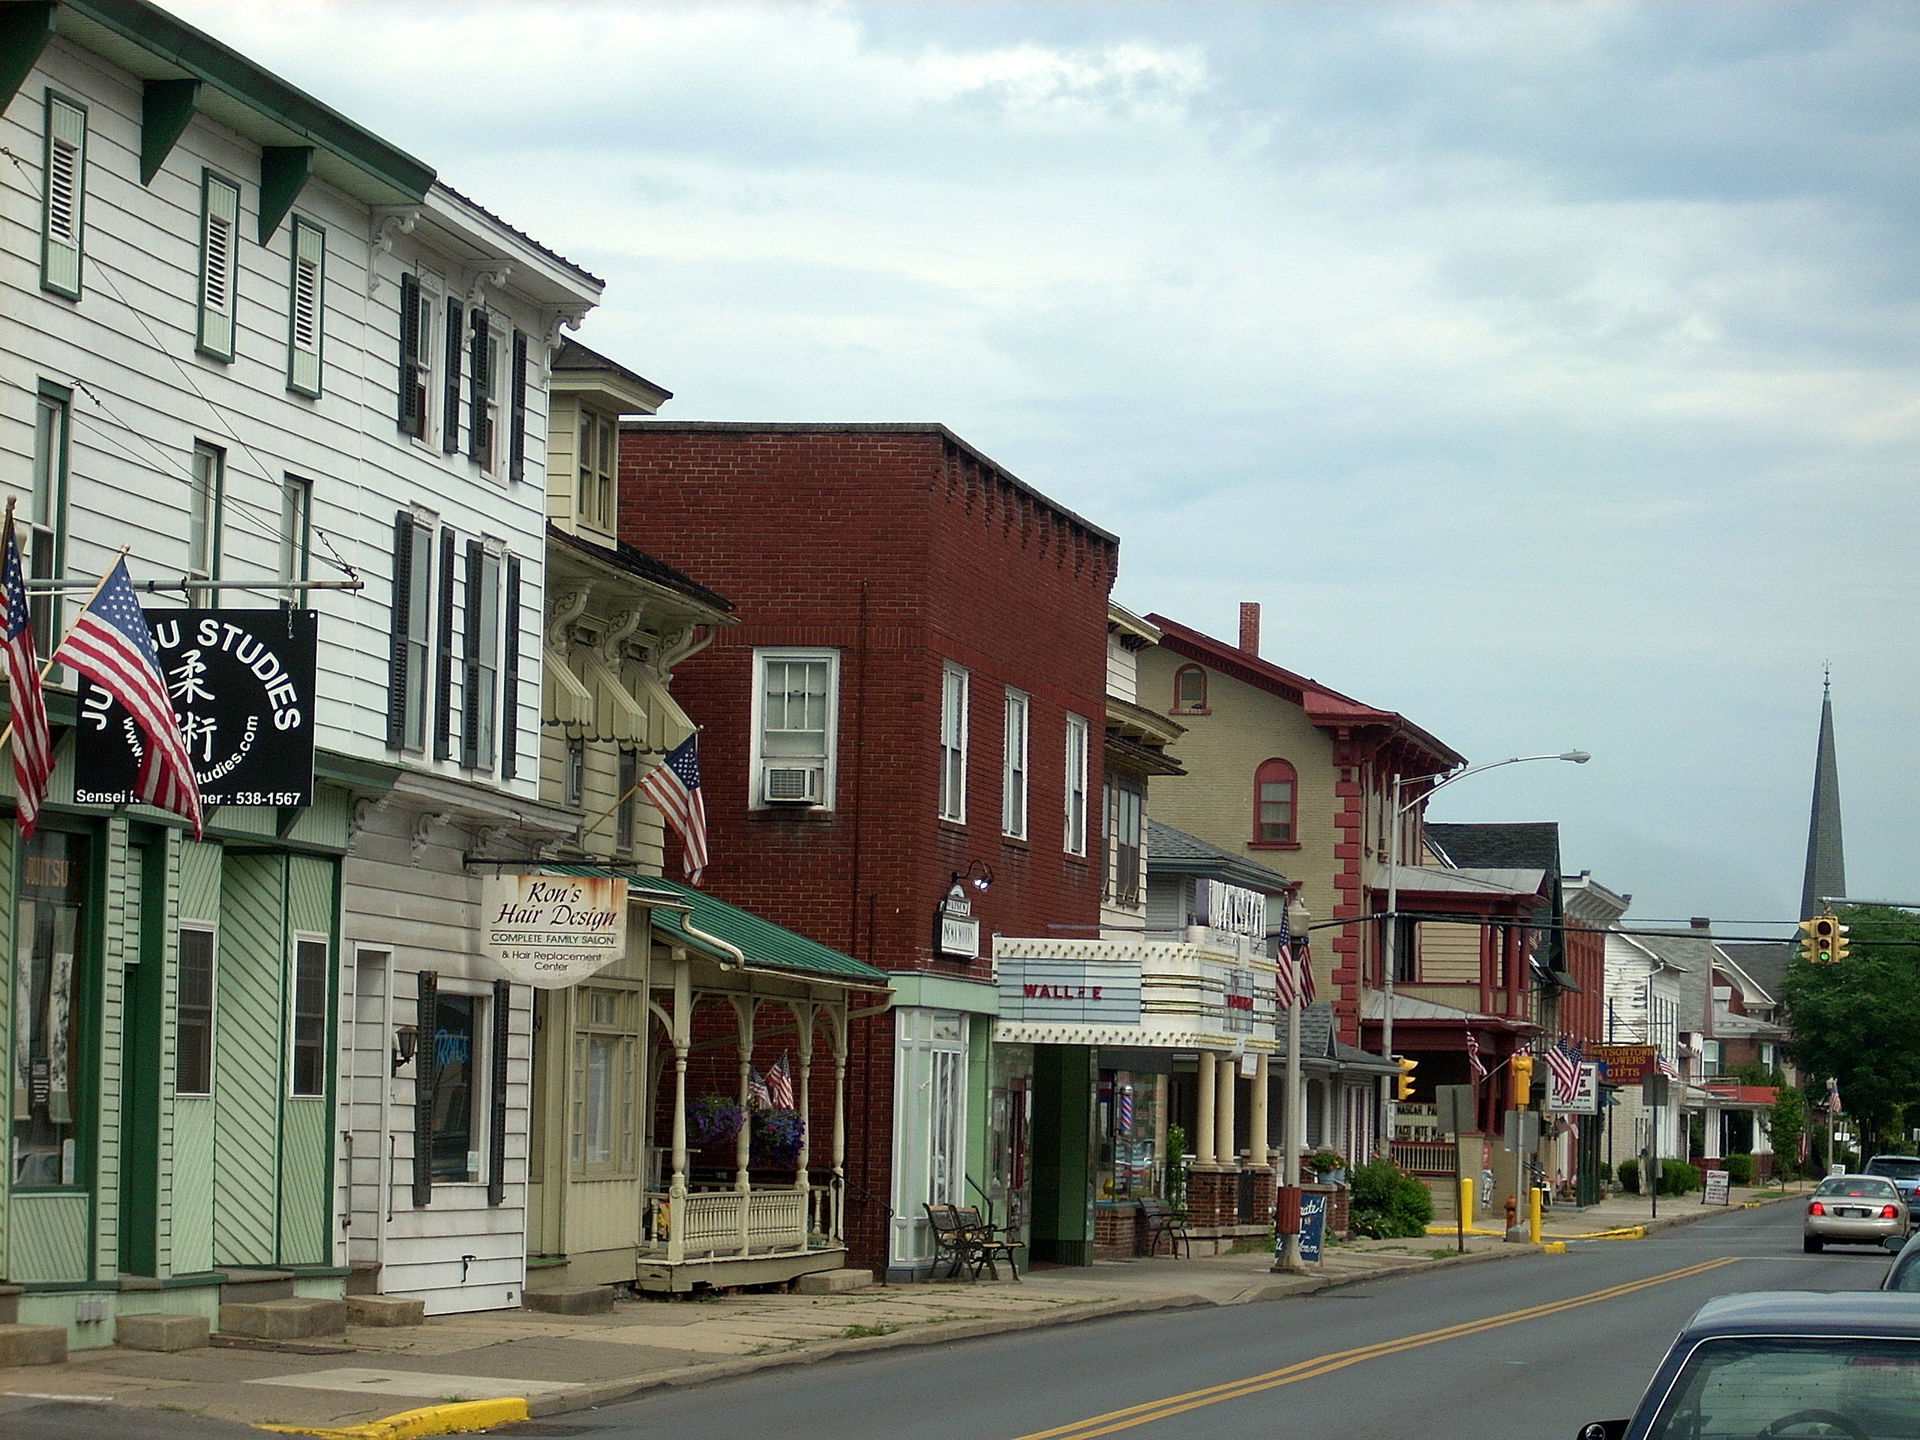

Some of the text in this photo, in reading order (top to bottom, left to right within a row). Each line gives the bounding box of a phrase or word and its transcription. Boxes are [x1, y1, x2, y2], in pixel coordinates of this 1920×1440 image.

[196, 619, 301, 731] STUDIES
[76, 789, 125, 803] Sensei
[236, 791, 301, 806] 538-1567
[527, 882, 582, 904] Ron's
[492, 903, 617, 931] Hair Design
[491, 933, 614, 945] COMPLETE FAMILY SALON
[502, 951, 602, 961] & Hair Replacement
[534, 962, 568, 971] Center
[1600, 1056, 1646, 1065] FLOWERS
[1607, 1068, 1640, 1077] GIFTS
